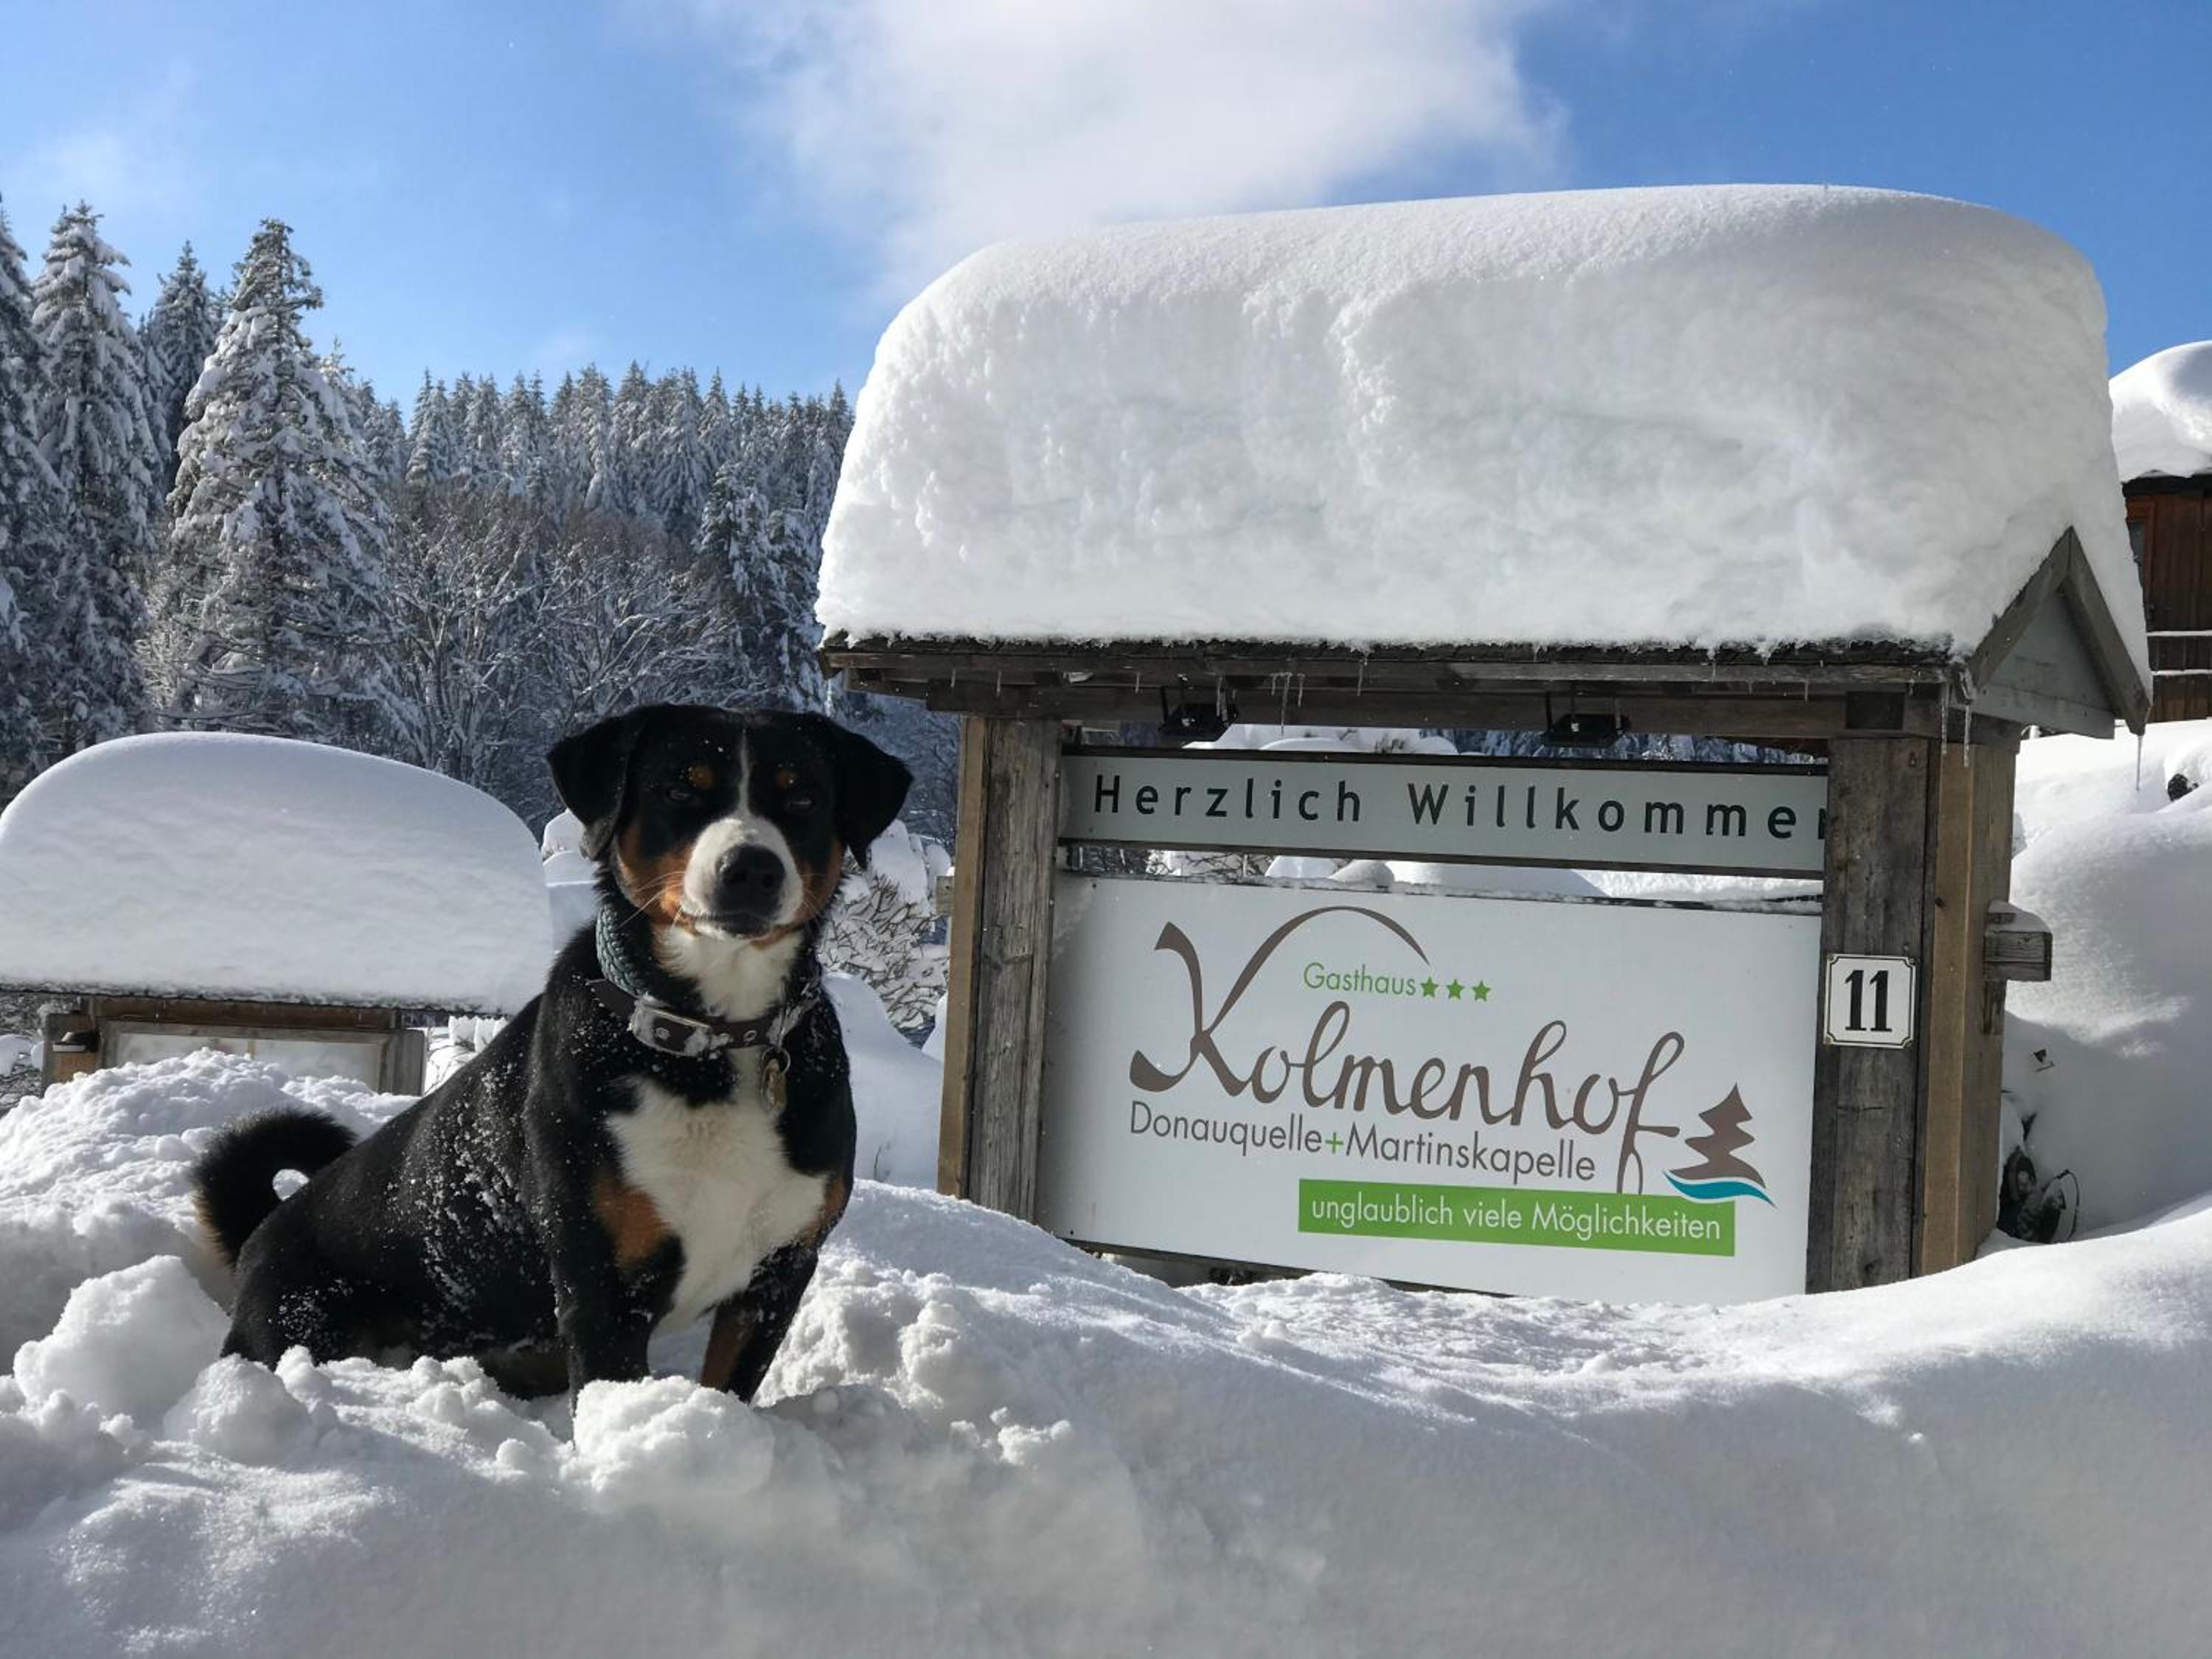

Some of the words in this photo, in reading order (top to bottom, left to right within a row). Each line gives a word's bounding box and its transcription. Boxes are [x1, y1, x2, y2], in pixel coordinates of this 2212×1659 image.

[1094, 775, 1360, 821] Herzlich
[1303, 962, 1416, 995] Gasthaus
[1845, 970, 1892, 1032] 11
[1129, 906, 1685, 1195] Kolmenhof
[1312, 1192, 1453, 1228] unglaublich
[1463, 1199, 1522, 1229] viele
[1532, 1203, 1720, 1242] Möglichkeiten
